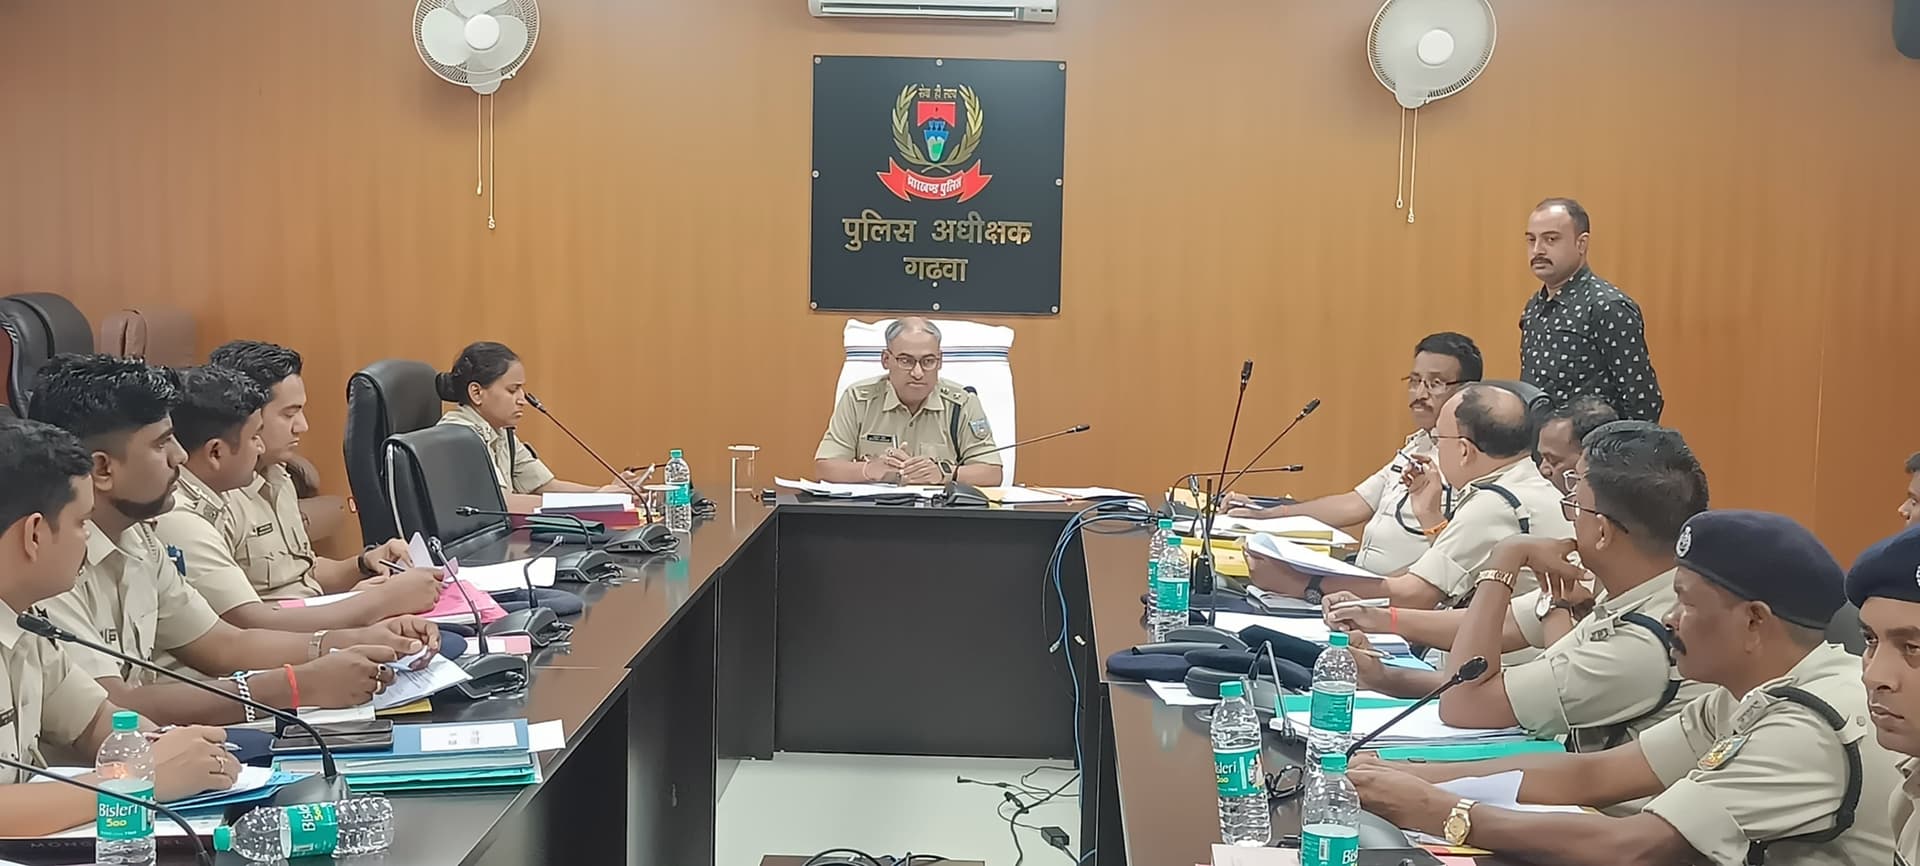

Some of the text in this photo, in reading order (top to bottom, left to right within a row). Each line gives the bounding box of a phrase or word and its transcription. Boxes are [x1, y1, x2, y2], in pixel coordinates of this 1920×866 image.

[940, 176, 963, 197] पुलिस
[842, 208, 1032, 251] पुलिस अधीक्षक
[98, 802, 138, 817] Bisleri
[106, 818, 127, 827] 500
